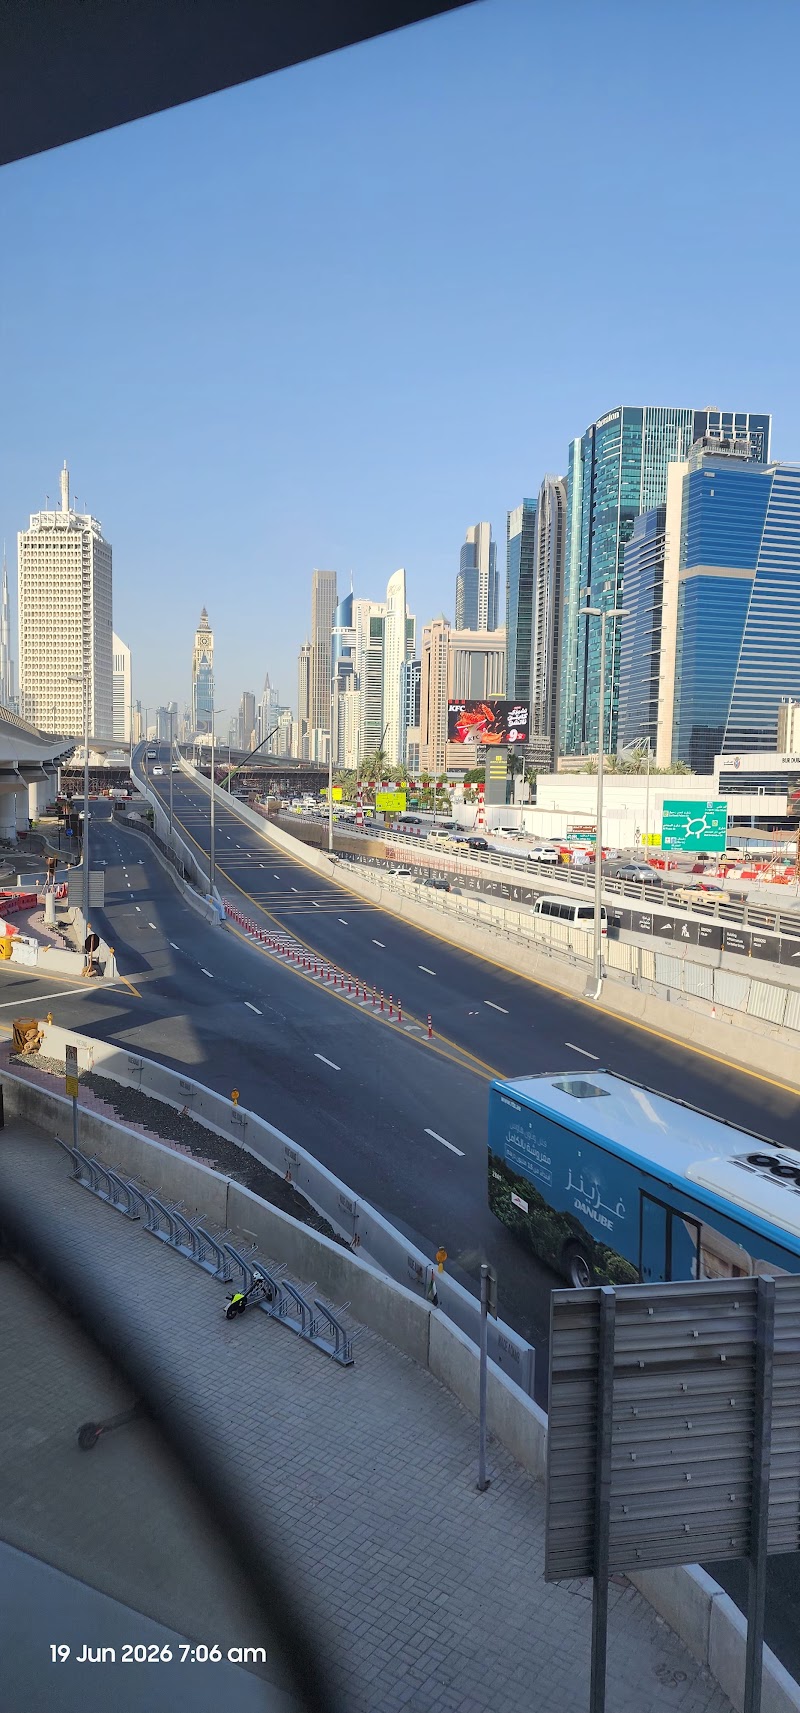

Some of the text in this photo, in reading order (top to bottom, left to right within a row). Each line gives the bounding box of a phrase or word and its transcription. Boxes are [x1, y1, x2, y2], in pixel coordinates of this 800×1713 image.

[509, 729, 518, 742] 9
[505, 1131, 551, 1165] مفروشة بالكامل
[565, 1168, 626, 1219] غرينز
[574, 1198, 614, 1231] DANUBE
